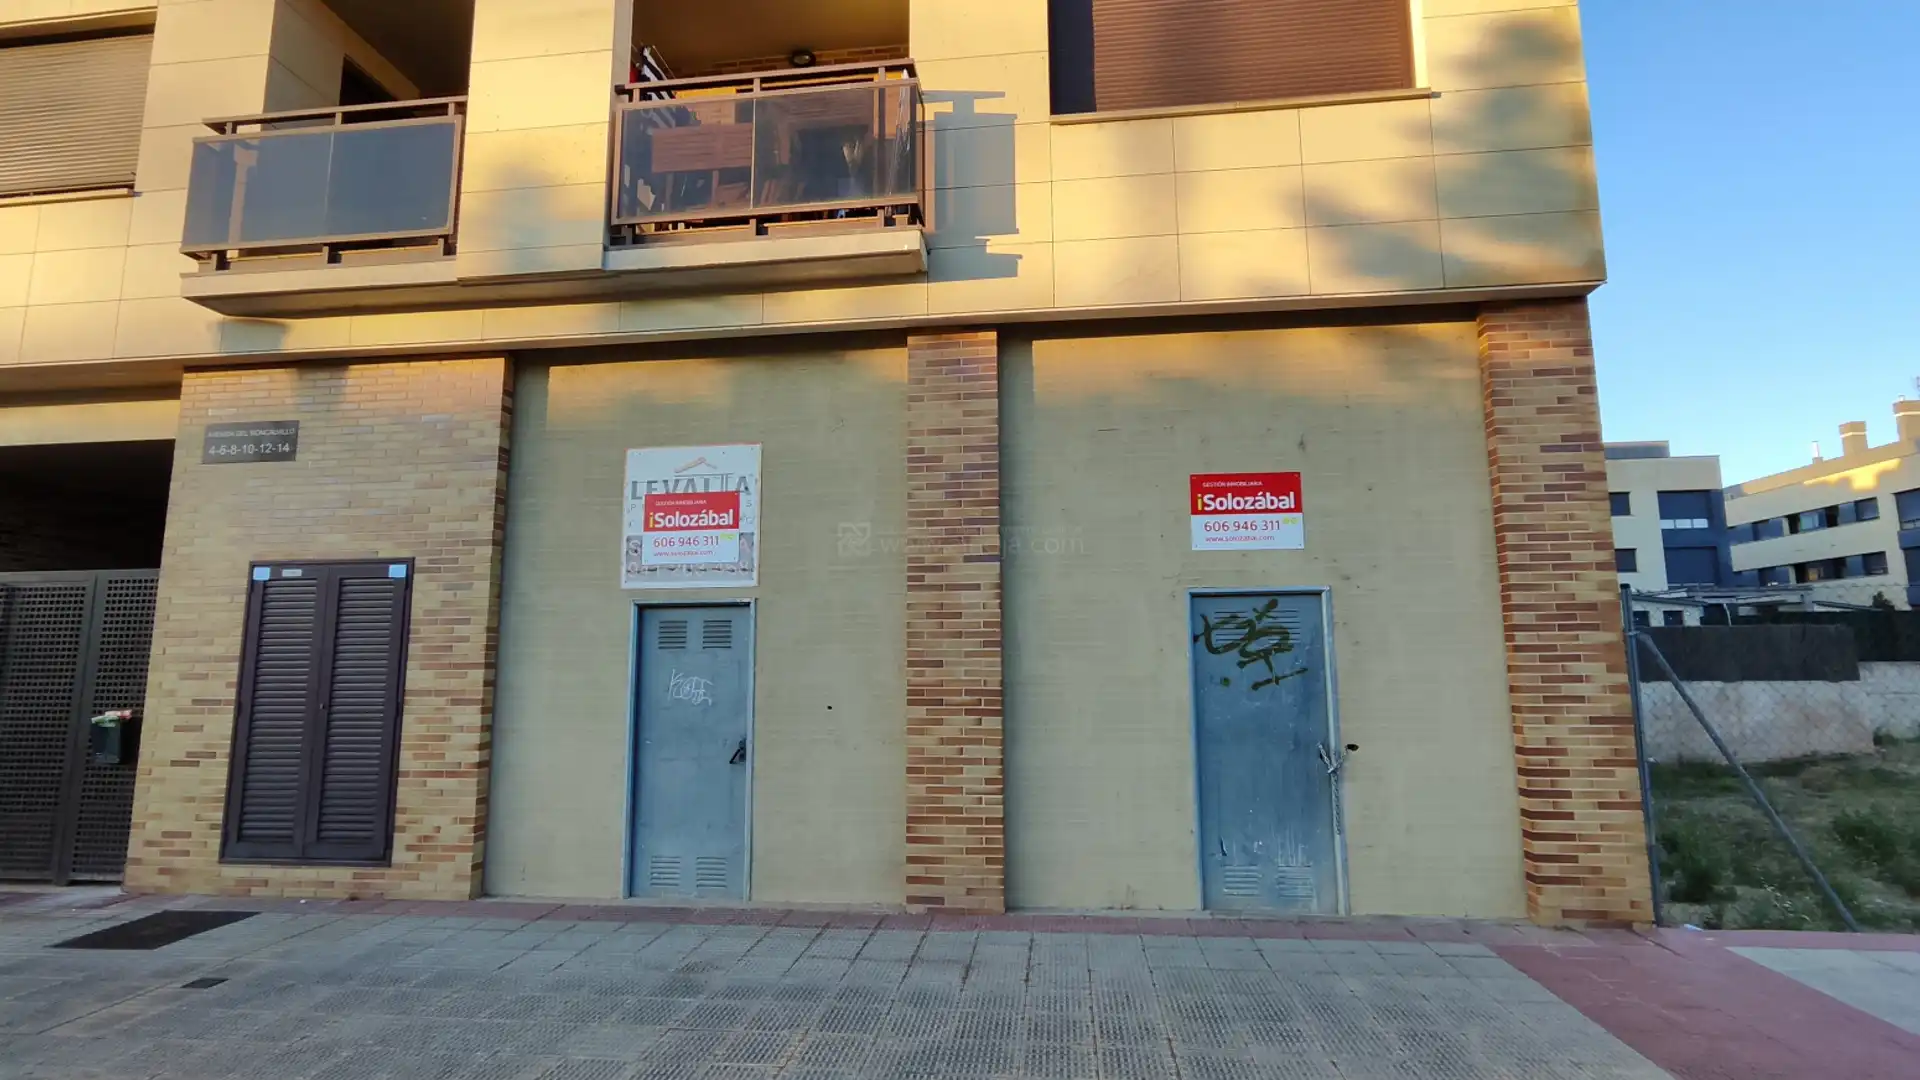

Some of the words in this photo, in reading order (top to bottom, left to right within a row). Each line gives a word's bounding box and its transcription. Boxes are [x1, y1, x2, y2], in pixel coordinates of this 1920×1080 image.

[208, 443, 290, 456] 4-6-8-10-12-14
[1197, 491, 1295, 511] iSolozábal
[1204, 521, 1230, 532] 606
[1233, 520, 1257, 531] 946
[1261, 519, 1280, 531] 311
[653, 537, 675, 548] 606
[678, 536, 700, 547] 946
[703, 535, 719, 546] 311
